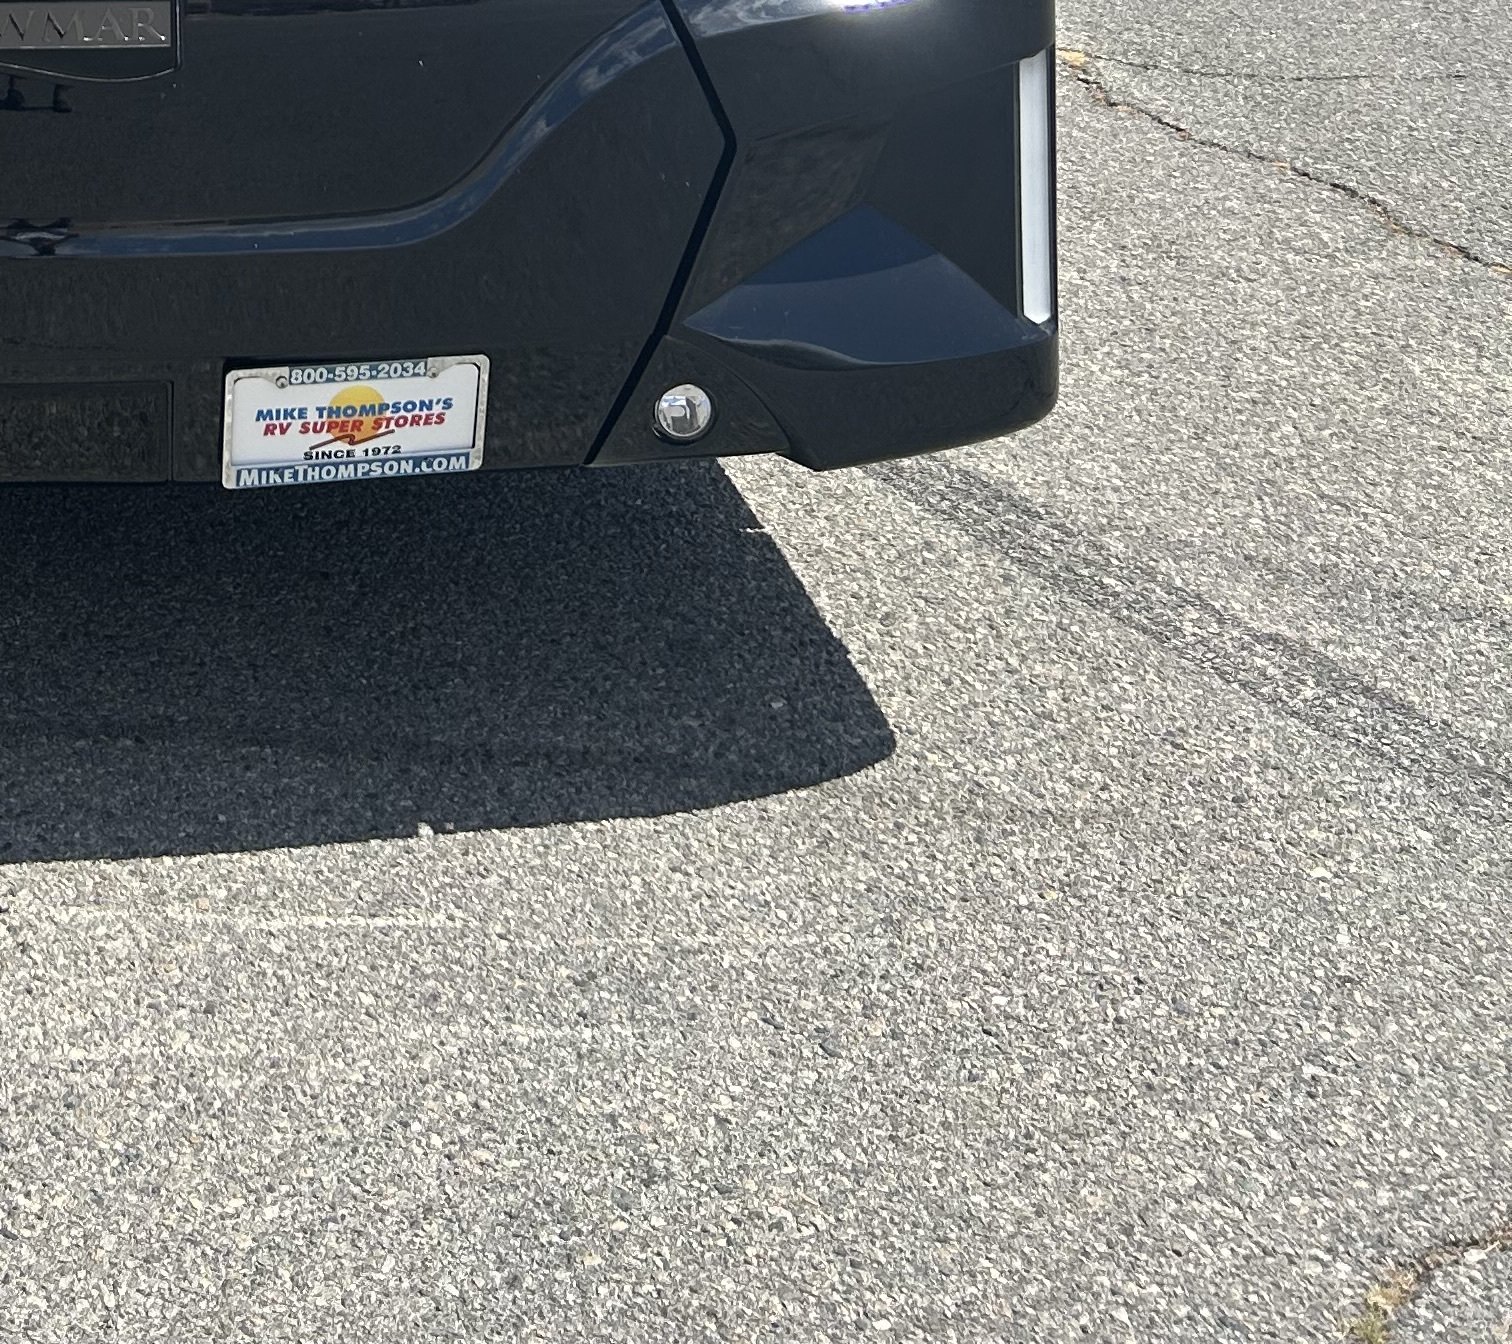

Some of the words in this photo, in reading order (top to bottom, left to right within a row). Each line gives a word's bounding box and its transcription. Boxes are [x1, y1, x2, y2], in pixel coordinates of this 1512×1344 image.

[290, 362, 426, 384] 800-595-2034
[255, 406, 309, 422] MIKE
[315, 397, 454, 419] THOMPSON'S
[263, 422, 292, 436] RV
[298, 419, 364, 434] SUPER
[371, 412, 446, 429] STORES
[303, 449, 356, 461] SINCE
[363, 444, 402, 457] 1972
